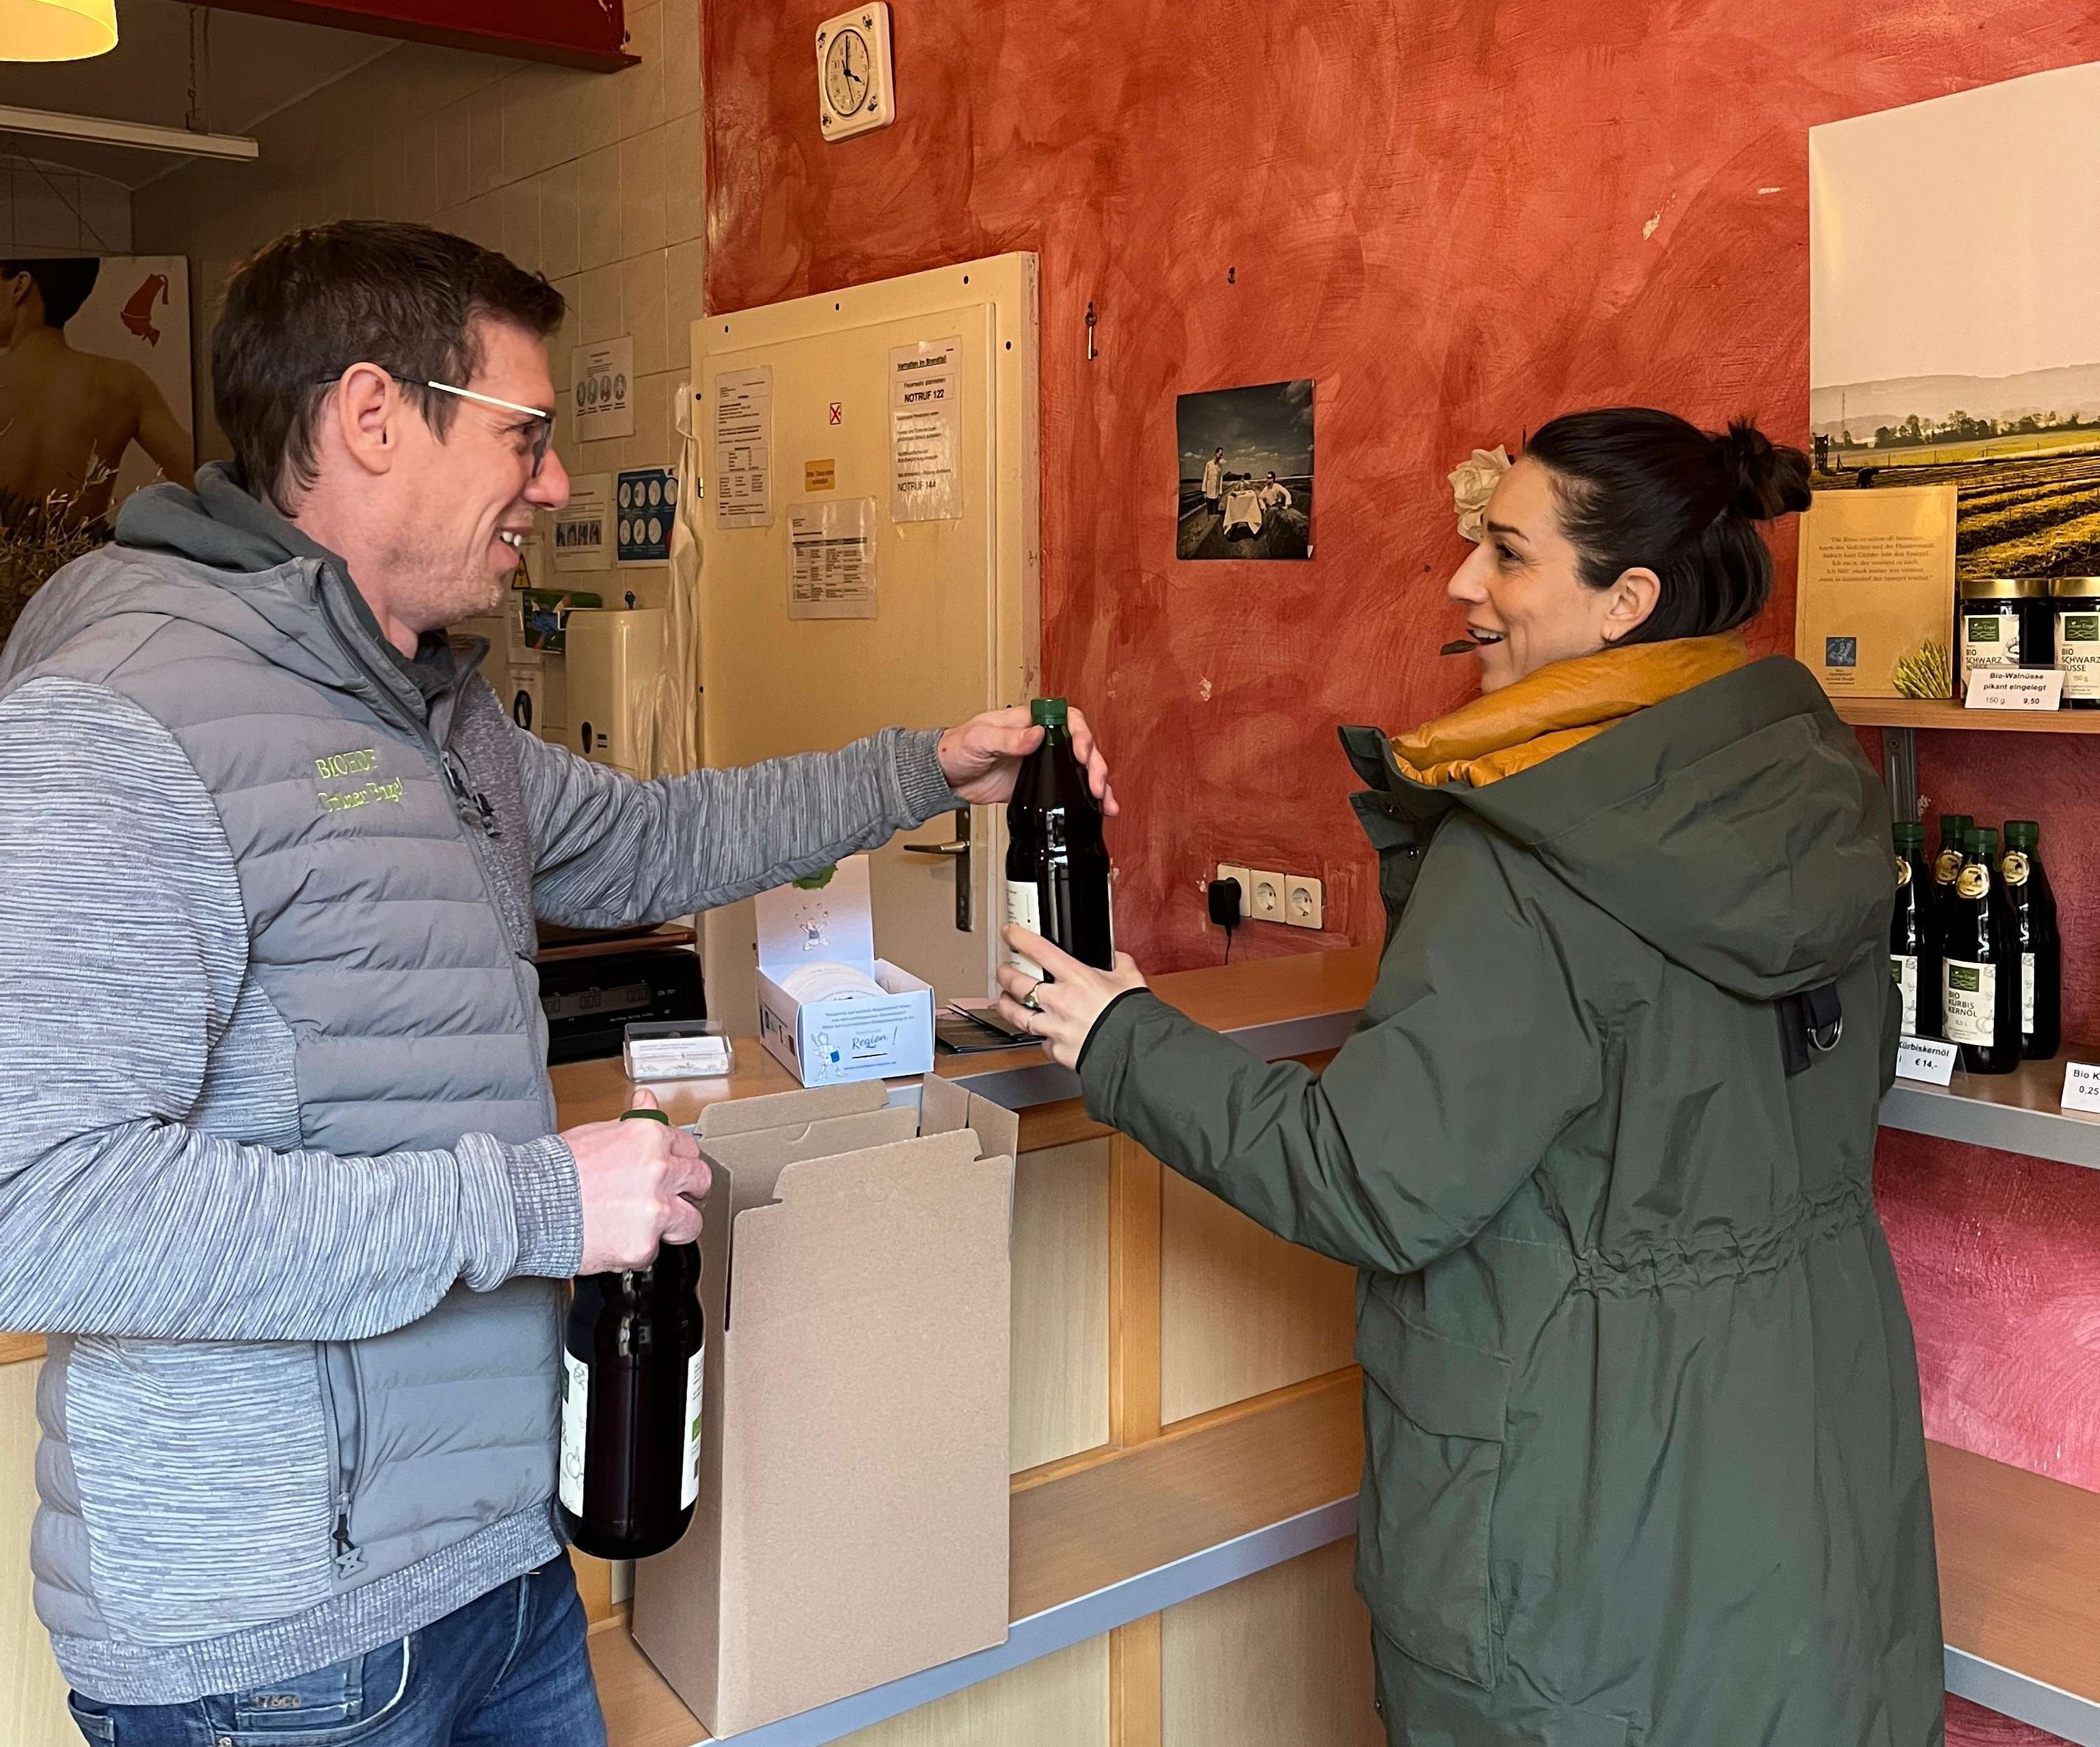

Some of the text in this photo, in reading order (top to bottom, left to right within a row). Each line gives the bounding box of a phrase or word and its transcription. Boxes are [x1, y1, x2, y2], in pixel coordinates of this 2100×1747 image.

[904, 389, 944, 403] NOTRUF 122
[898, 481, 923, 491] NOTRUF
[1966, 656, 2002, 664] SCHWARZ
[2061, 656, 2100, 664] SCHWARZ
[1948, 990, 1960, 999] BIO
[2073, 1069, 2090, 1079] Bio
[2079, 1085, 2099, 1096] 0,25
